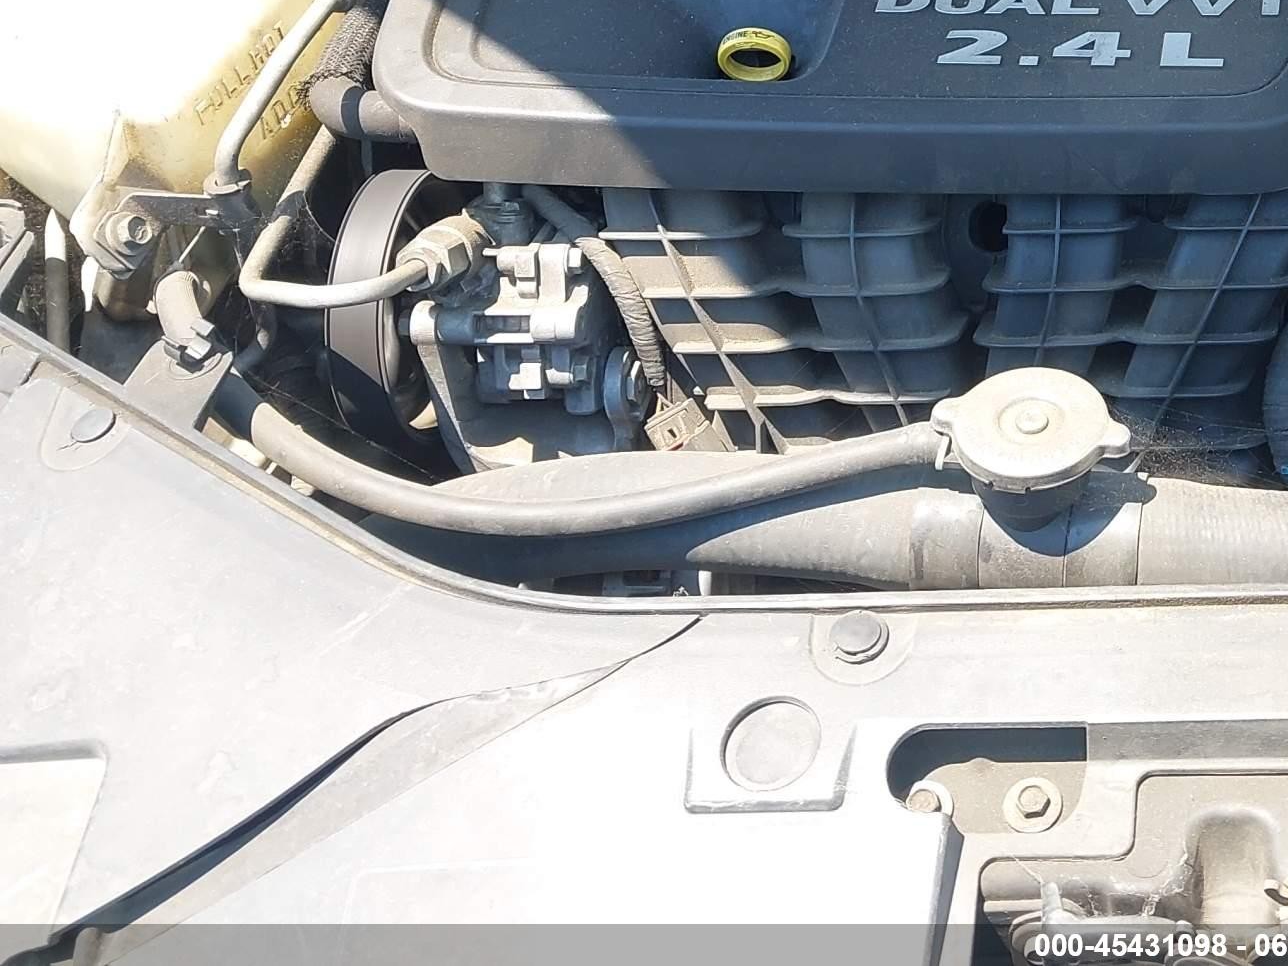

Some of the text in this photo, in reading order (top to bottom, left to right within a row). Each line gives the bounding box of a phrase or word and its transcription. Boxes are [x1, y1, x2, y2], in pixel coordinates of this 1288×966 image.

[722, 30, 748, 45] ENGINE
[936, 29, 1225, 67] 2.4 L
[194, 20, 284, 126] FULL HOT
